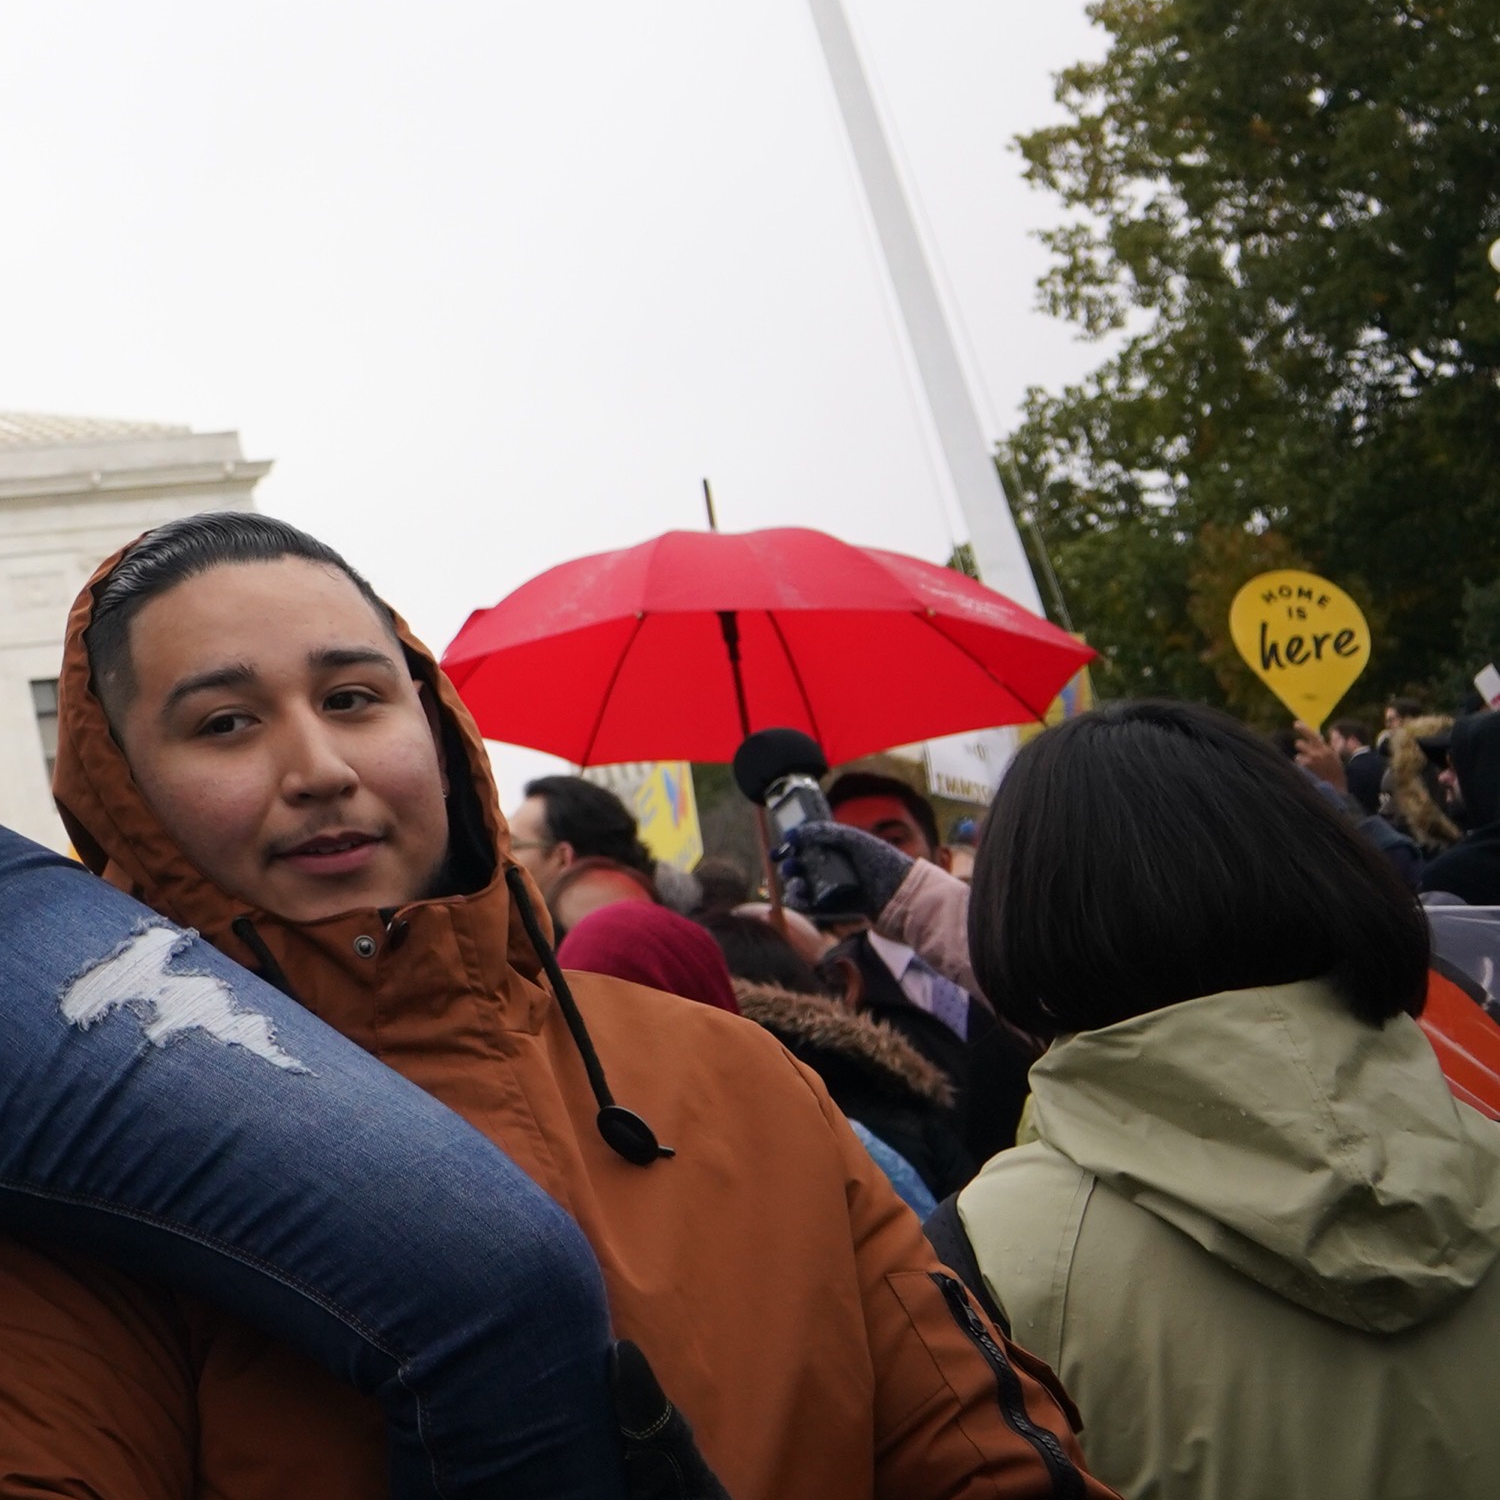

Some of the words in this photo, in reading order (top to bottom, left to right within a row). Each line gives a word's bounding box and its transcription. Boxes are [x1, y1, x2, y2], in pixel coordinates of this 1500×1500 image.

[1261, 584, 1331, 607] HOME
[1286, 604, 1307, 620] IS
[1260, 620, 1360, 671] here
